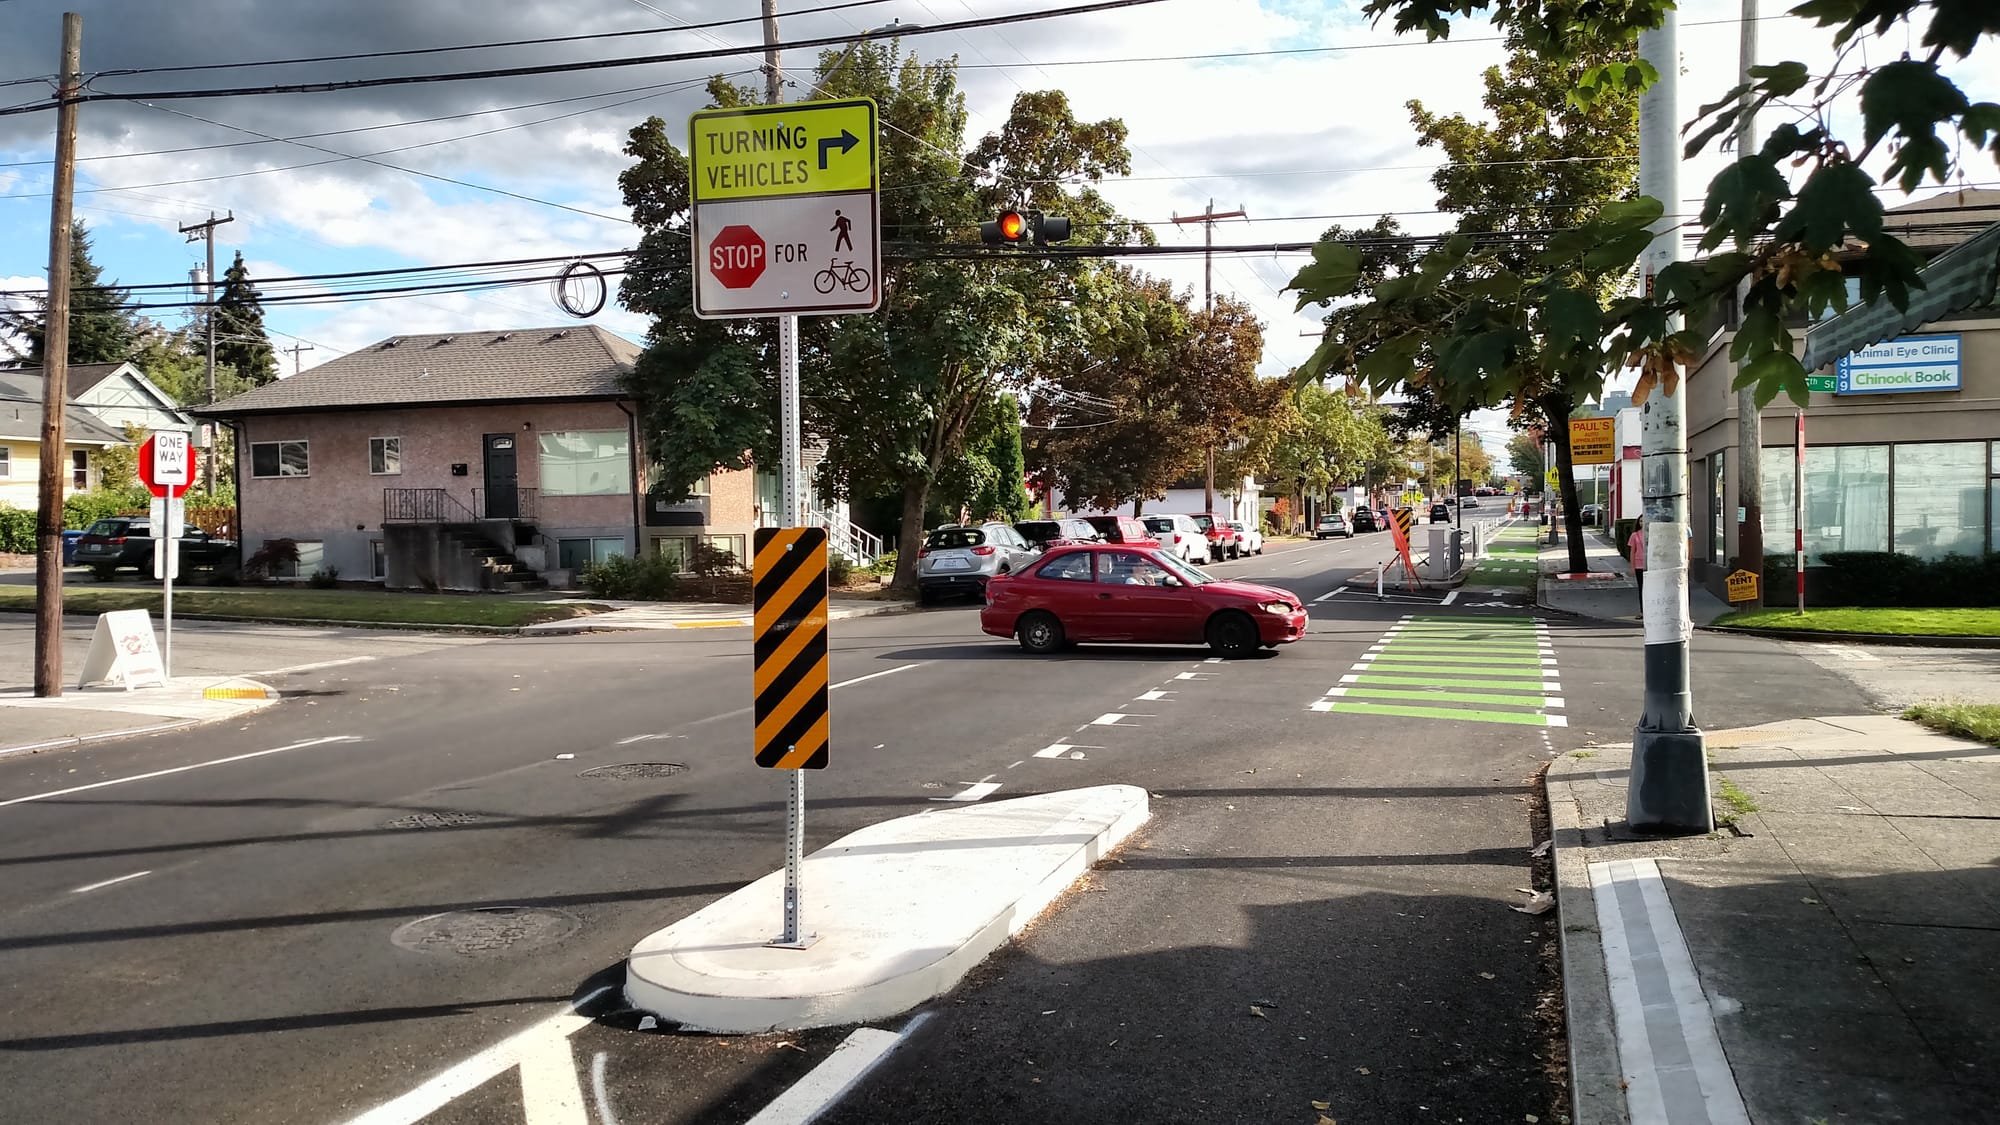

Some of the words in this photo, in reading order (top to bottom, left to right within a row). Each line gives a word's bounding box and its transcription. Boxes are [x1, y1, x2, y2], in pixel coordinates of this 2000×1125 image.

[706, 126, 808, 155] TURNING
[707, 160, 809, 189] VEHICLES
[713, 244, 763, 270] STOP
[775, 244, 808, 263] FOR
[1853, 348, 1893, 359] Animal
[1897, 346, 1918, 357] Eye
[1922, 344, 1955, 355] Clinic
[1824, 380, 1835, 389] St
[1855, 372, 1912, 385] Chinook
[1915, 370, 1952, 383] Book
[1573, 421, 1610, 431] PAUL'S
[160, 435, 183, 448] ONE
[159, 451, 183, 462] WAY
[1730, 575, 1753, 585] RENT
